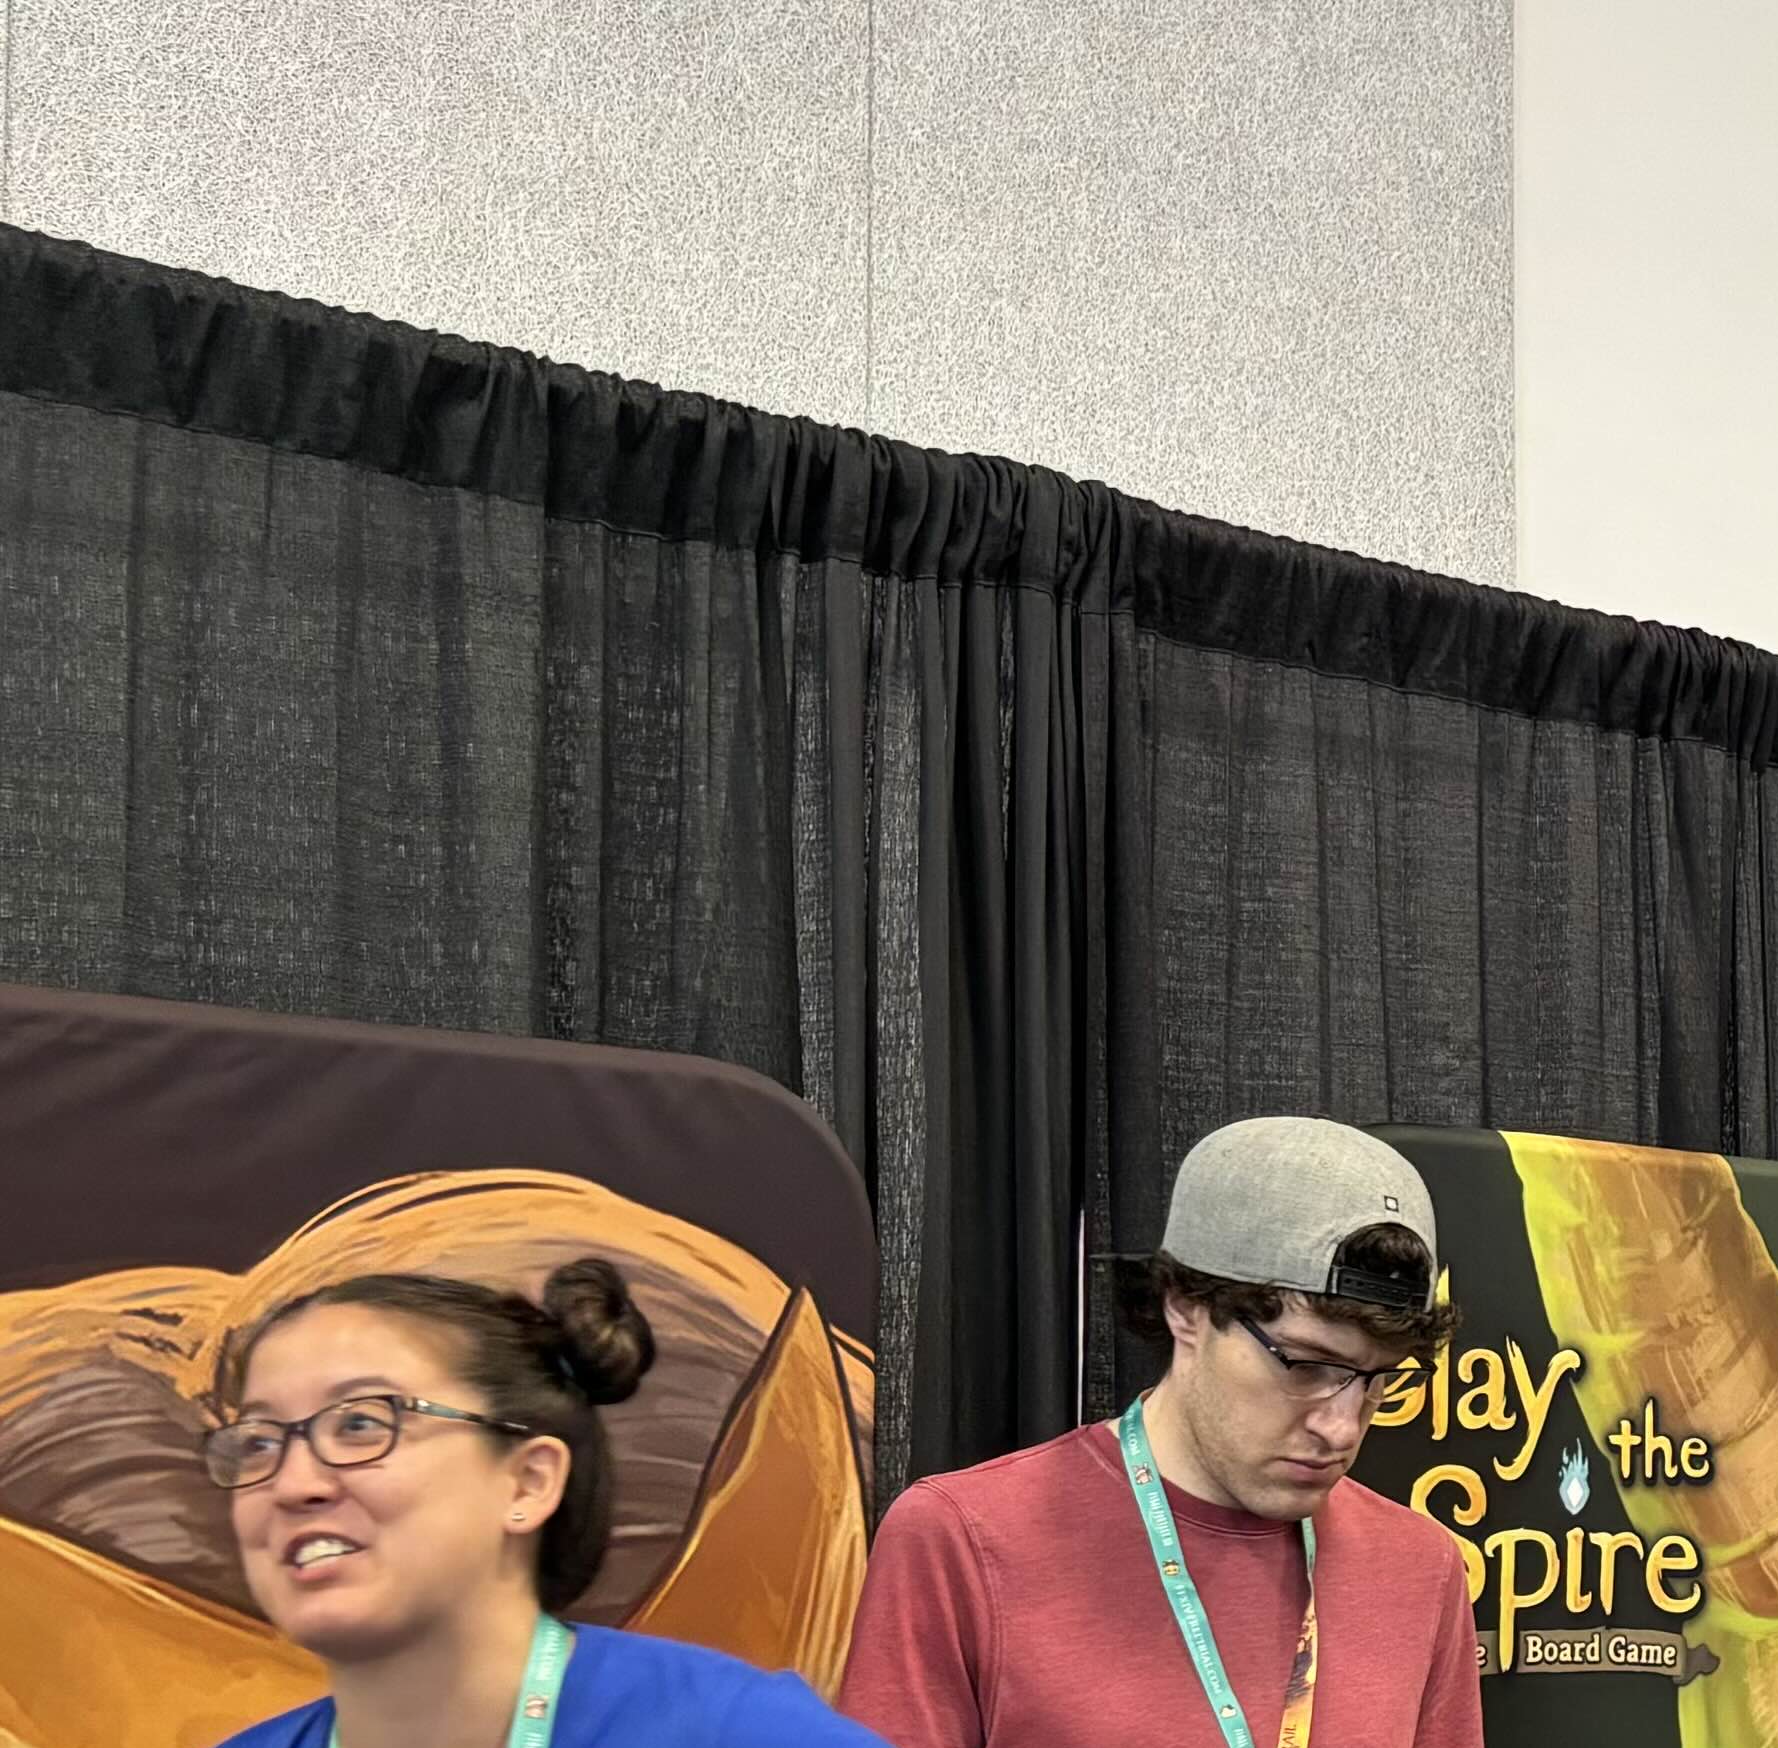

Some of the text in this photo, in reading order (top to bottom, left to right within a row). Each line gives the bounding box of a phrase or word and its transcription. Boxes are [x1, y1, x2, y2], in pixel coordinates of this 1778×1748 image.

[1608, 1399, 1709, 1481] the
[1525, 1635, 1677, 1667] Board Game
